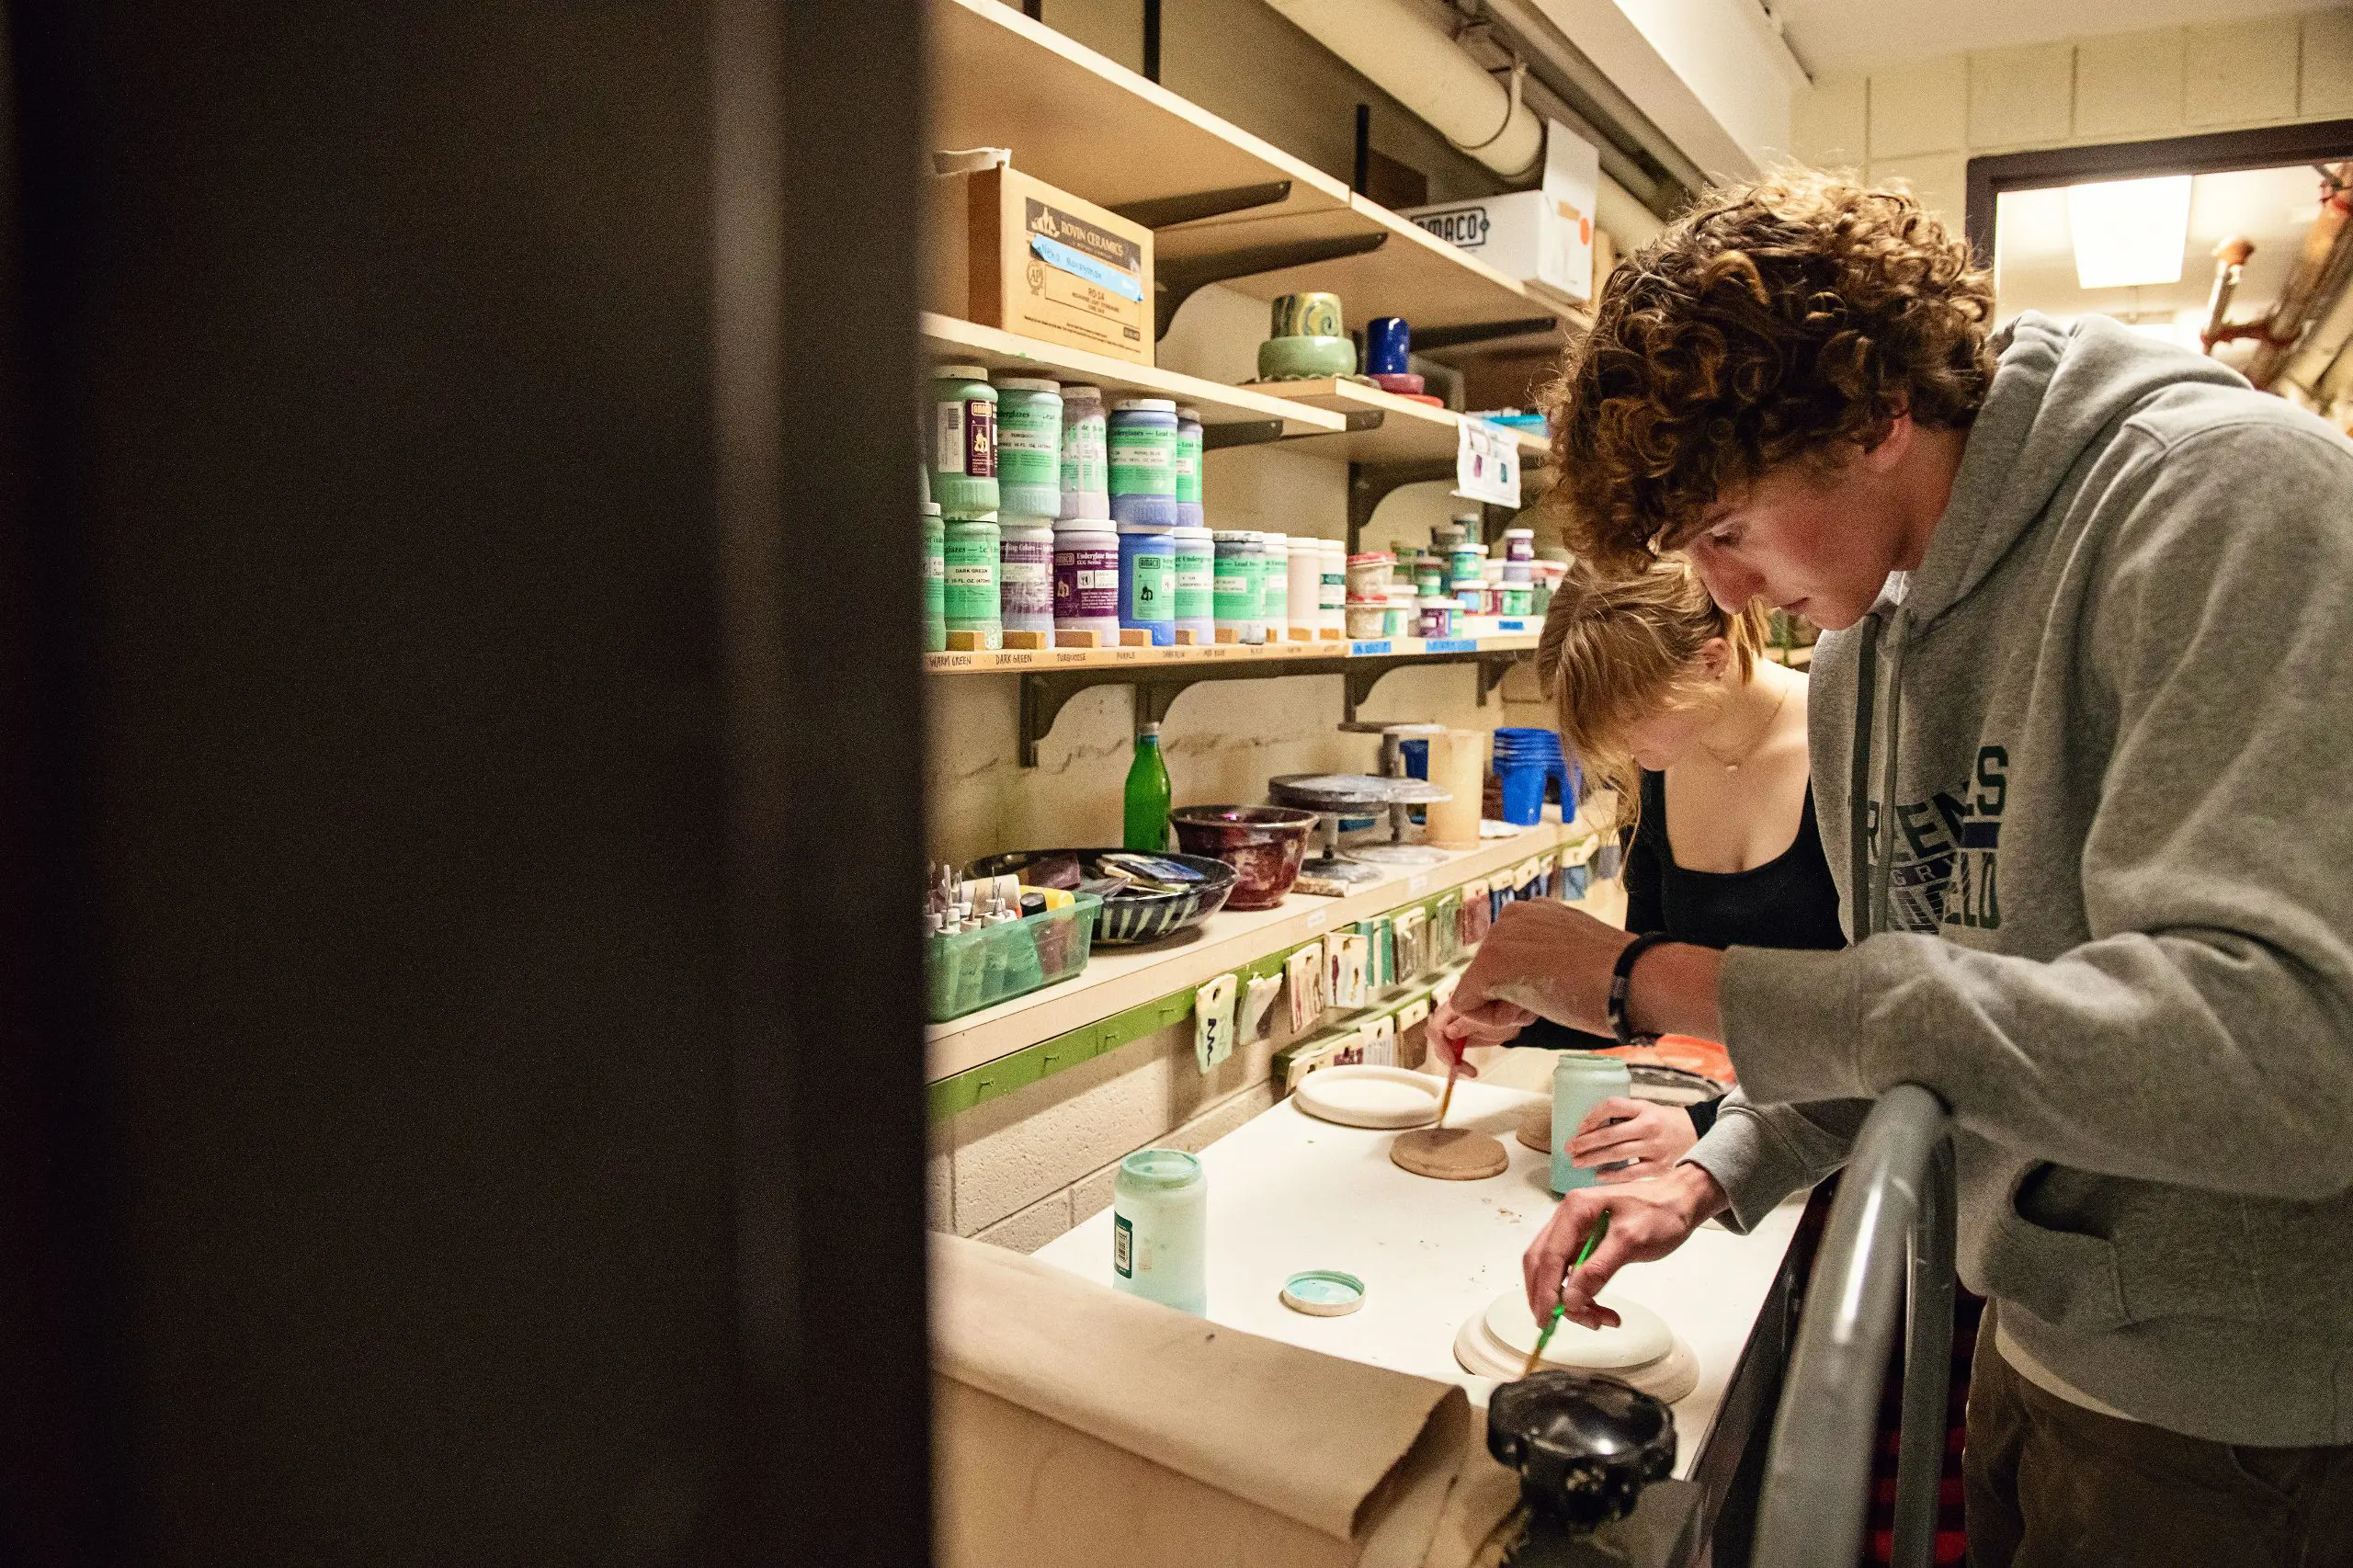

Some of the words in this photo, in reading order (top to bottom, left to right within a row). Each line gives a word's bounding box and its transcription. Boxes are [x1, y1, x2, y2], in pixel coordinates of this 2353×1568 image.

[929, 655, 950, 667] WARM
[951, 654, 972, 666] GREEN
[995, 654, 1012, 665] DARK
[1012, 653, 1032, 665] GREEN
